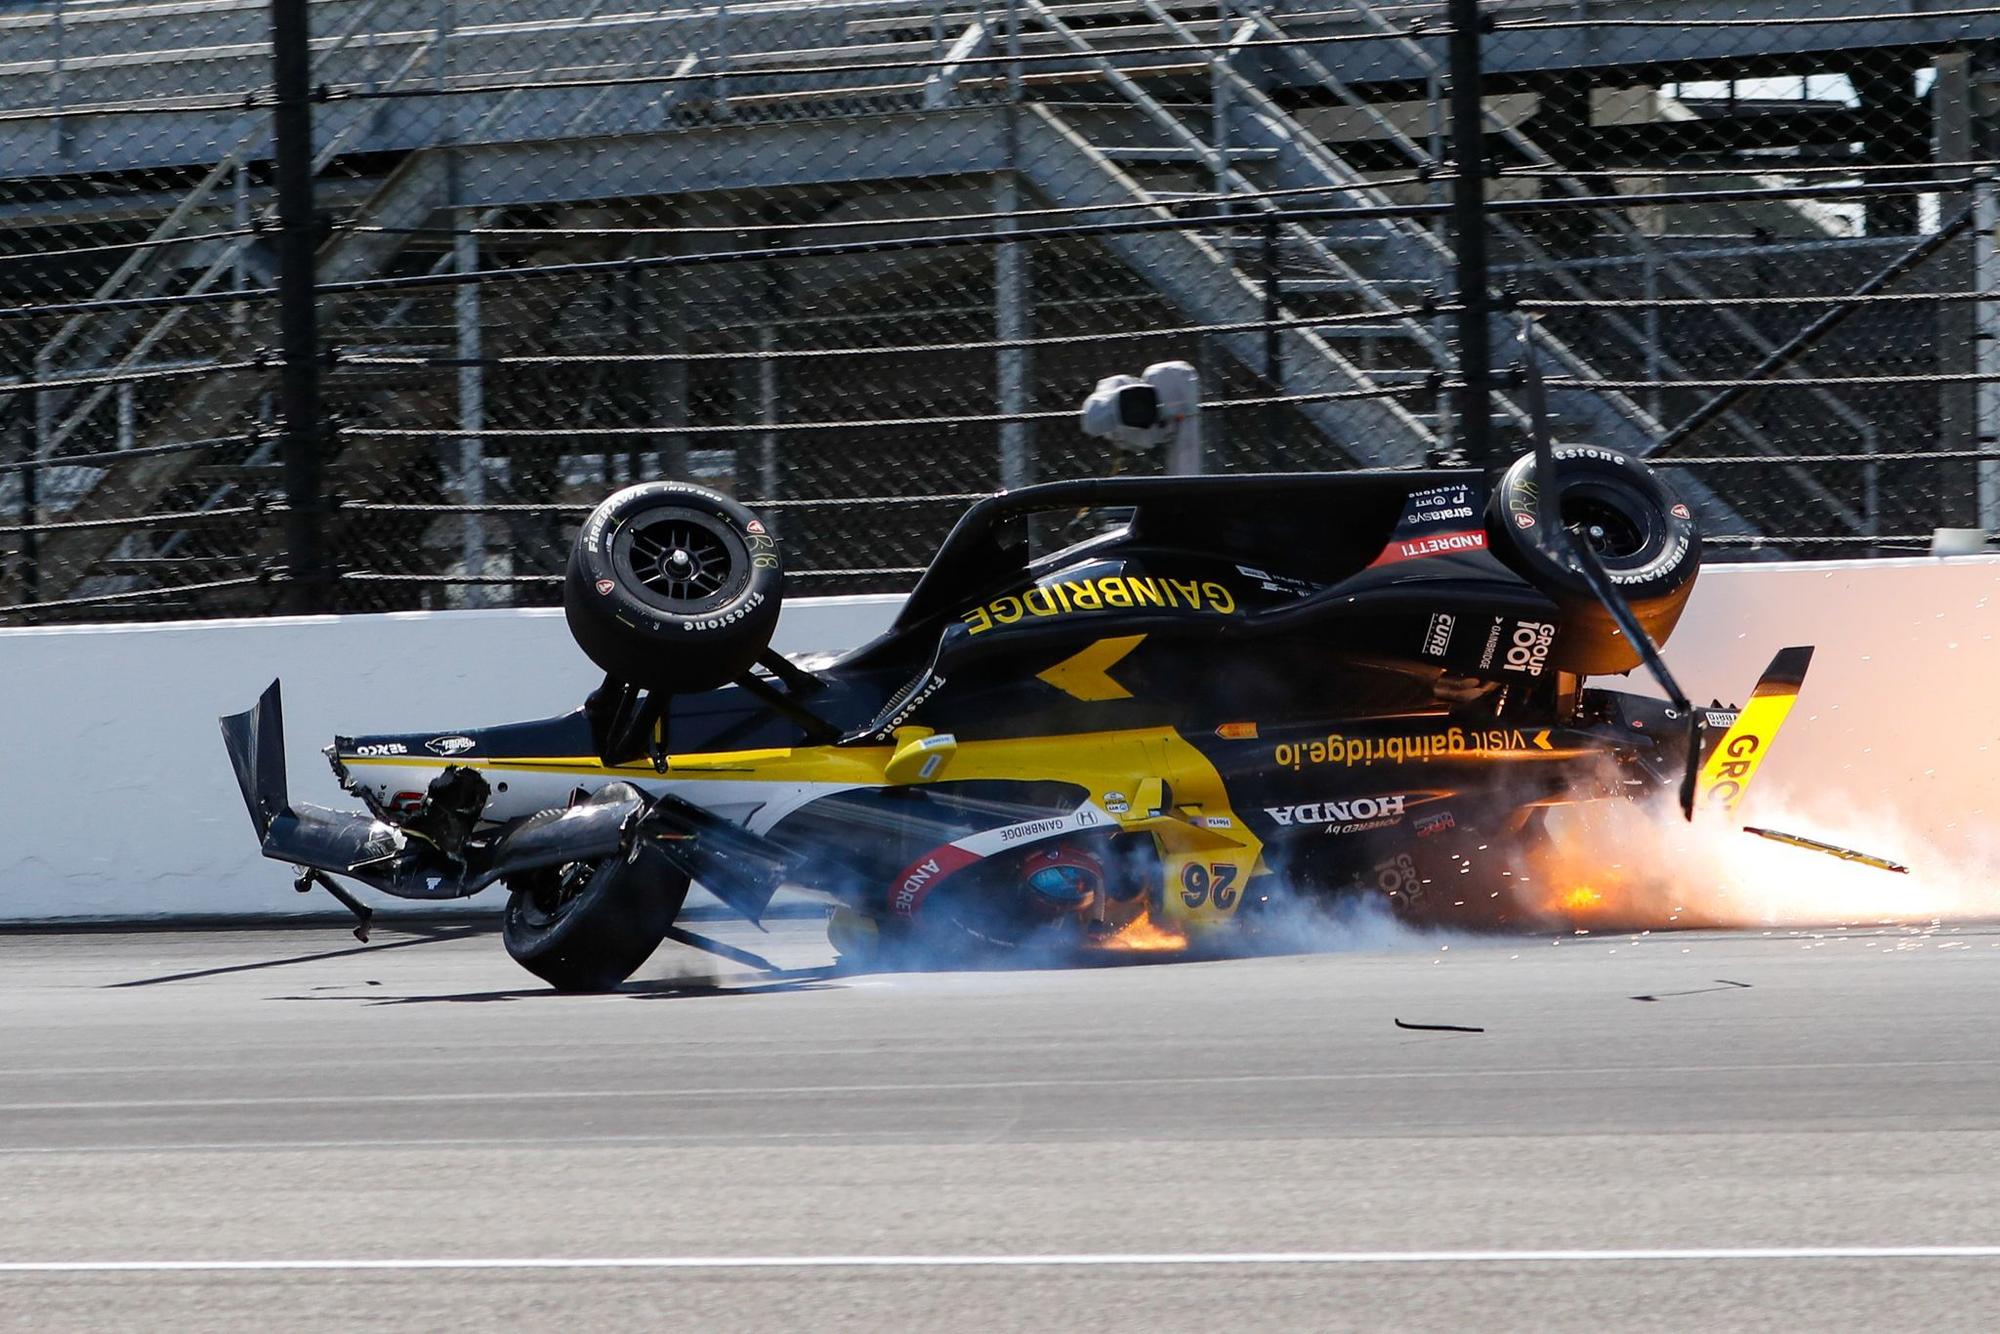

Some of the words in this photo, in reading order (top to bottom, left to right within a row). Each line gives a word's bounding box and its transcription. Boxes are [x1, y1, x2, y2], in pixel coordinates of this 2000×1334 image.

[1530, 447, 1626, 469] estone
[587, 486, 650, 554] FIREHAWK
[1408, 506, 1473, 524] stratasys
[1401, 534, 1483, 556] ANDRETTI
[1609, 535, 1690, 585] FIREHAWK
[683, 591, 767, 632] Firestone
[961, 578, 1236, 634] GAINBRIDGE
[1429, 614, 1452, 657] CURB
[1479, 625, 1501, 670] GAINBRIDGE
[1503, 621, 1541, 672] 1001
[1525, 624, 1556, 677] GROUP
[875, 675, 947, 742] Firestone
[1275, 728, 1465, 769] gainbridge.io
[1471, 729, 1526, 758] visit
[1708, 735, 1759, 803] GRO
[1000, 819, 1064, 842] GAINBRIDGE
[1207, 818, 1230, 827] Herta
[1263, 796, 1405, 824] HONDA
[1323, 823, 1342, 836] by
[1180, 862, 1238, 911] 26
